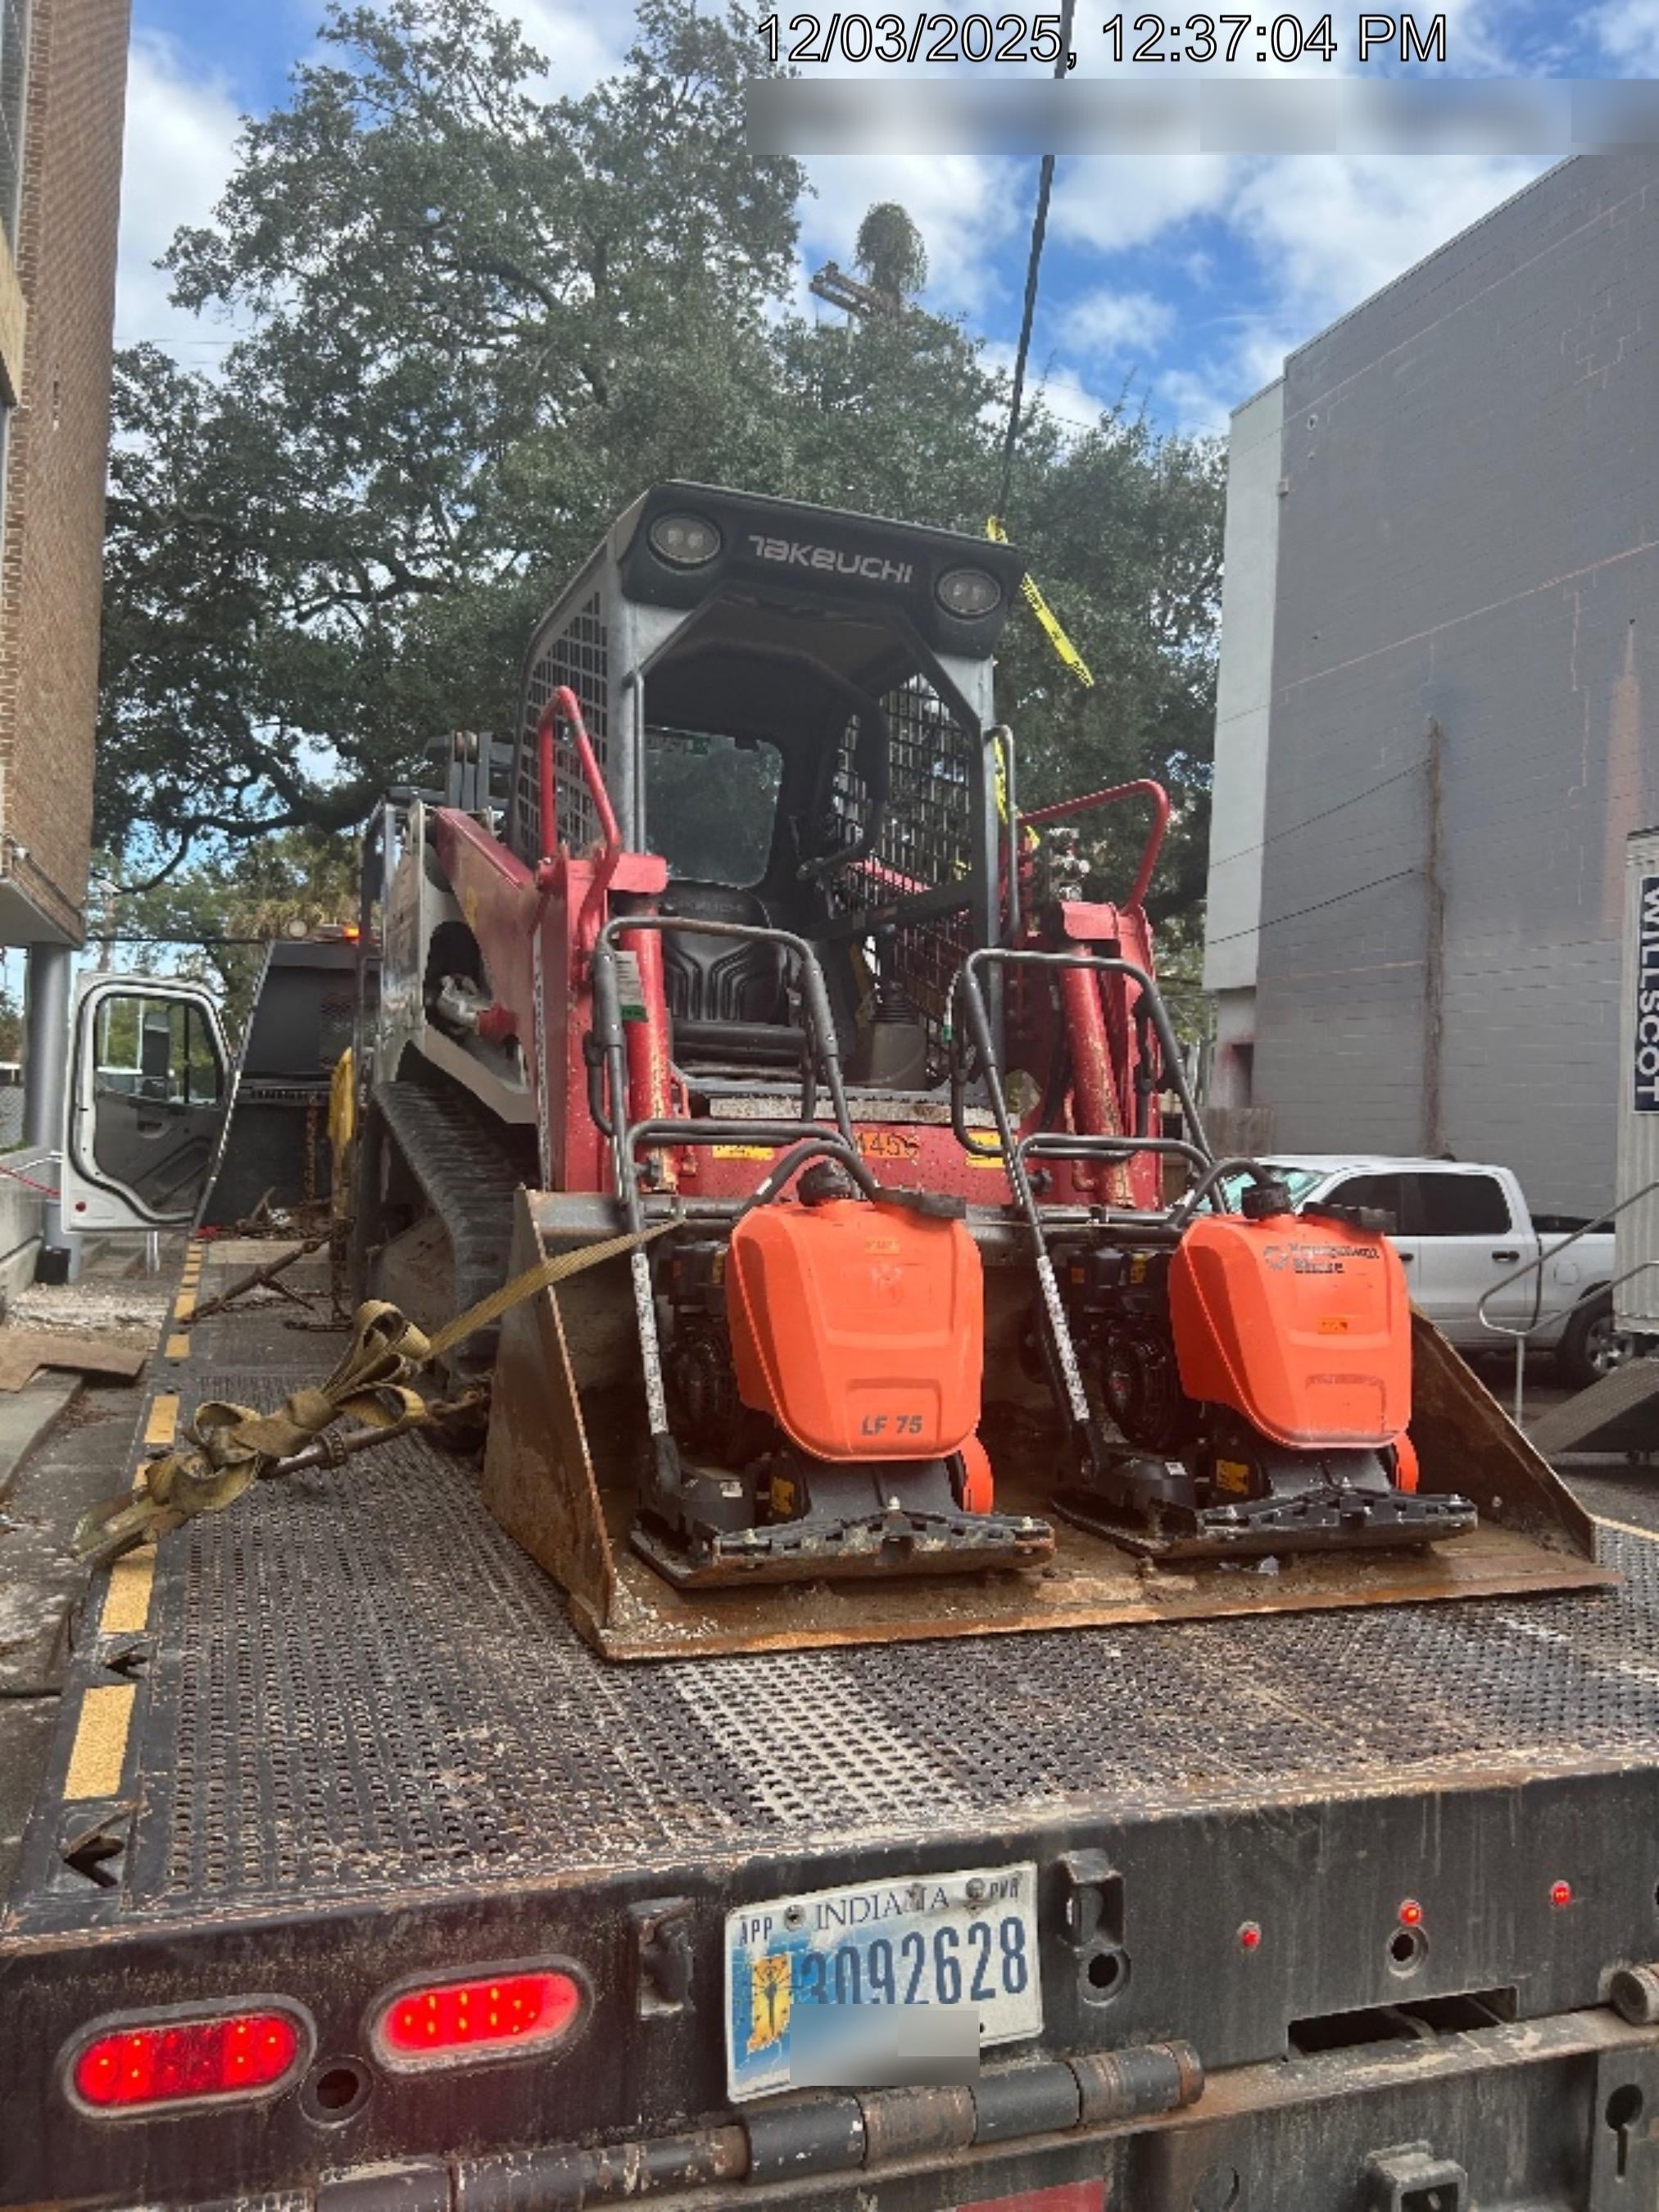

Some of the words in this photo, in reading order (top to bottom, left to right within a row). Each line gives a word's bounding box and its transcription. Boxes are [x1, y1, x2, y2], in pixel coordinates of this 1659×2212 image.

[1637, 886, 1659, 1103] WILLSCOT
[861, 1415, 887, 1436] LF
[896, 1415, 922, 1435] 75
[739, 1916, 773, 1947] APP
